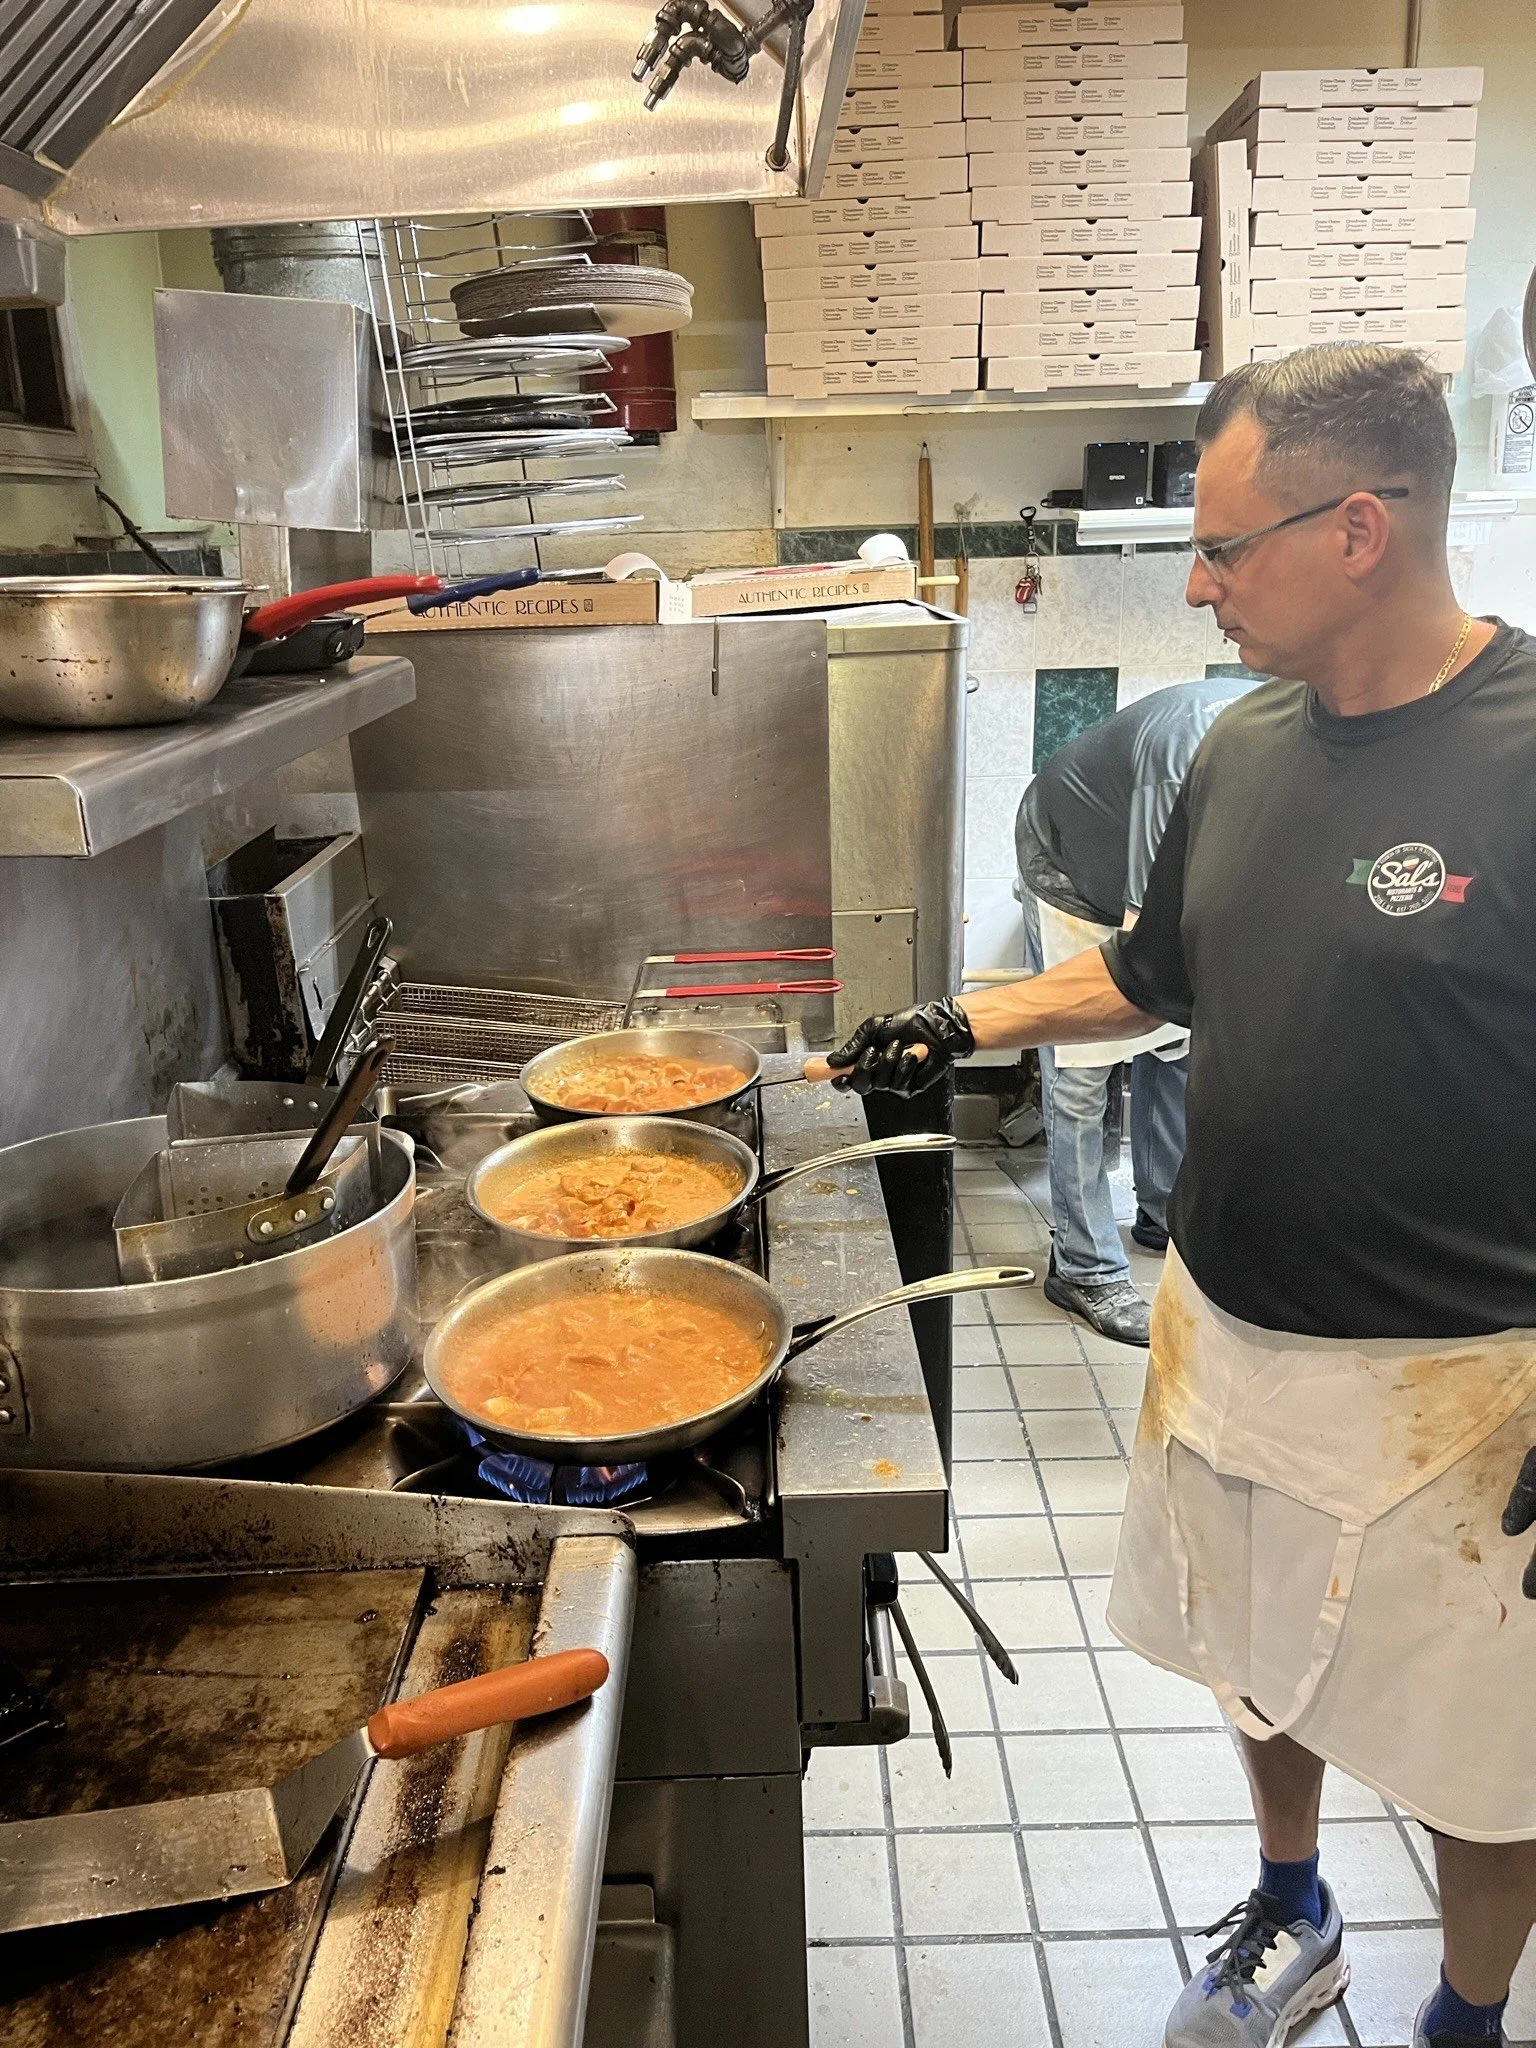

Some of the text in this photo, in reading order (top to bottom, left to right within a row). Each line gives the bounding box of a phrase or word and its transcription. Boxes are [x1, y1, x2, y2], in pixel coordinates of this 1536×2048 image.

[738, 583, 860, 604] AUTHENTIC RECIPES
[418, 599, 579, 619] UTHENTIC RECIPES
[1372, 860, 1440, 888] Sal's
